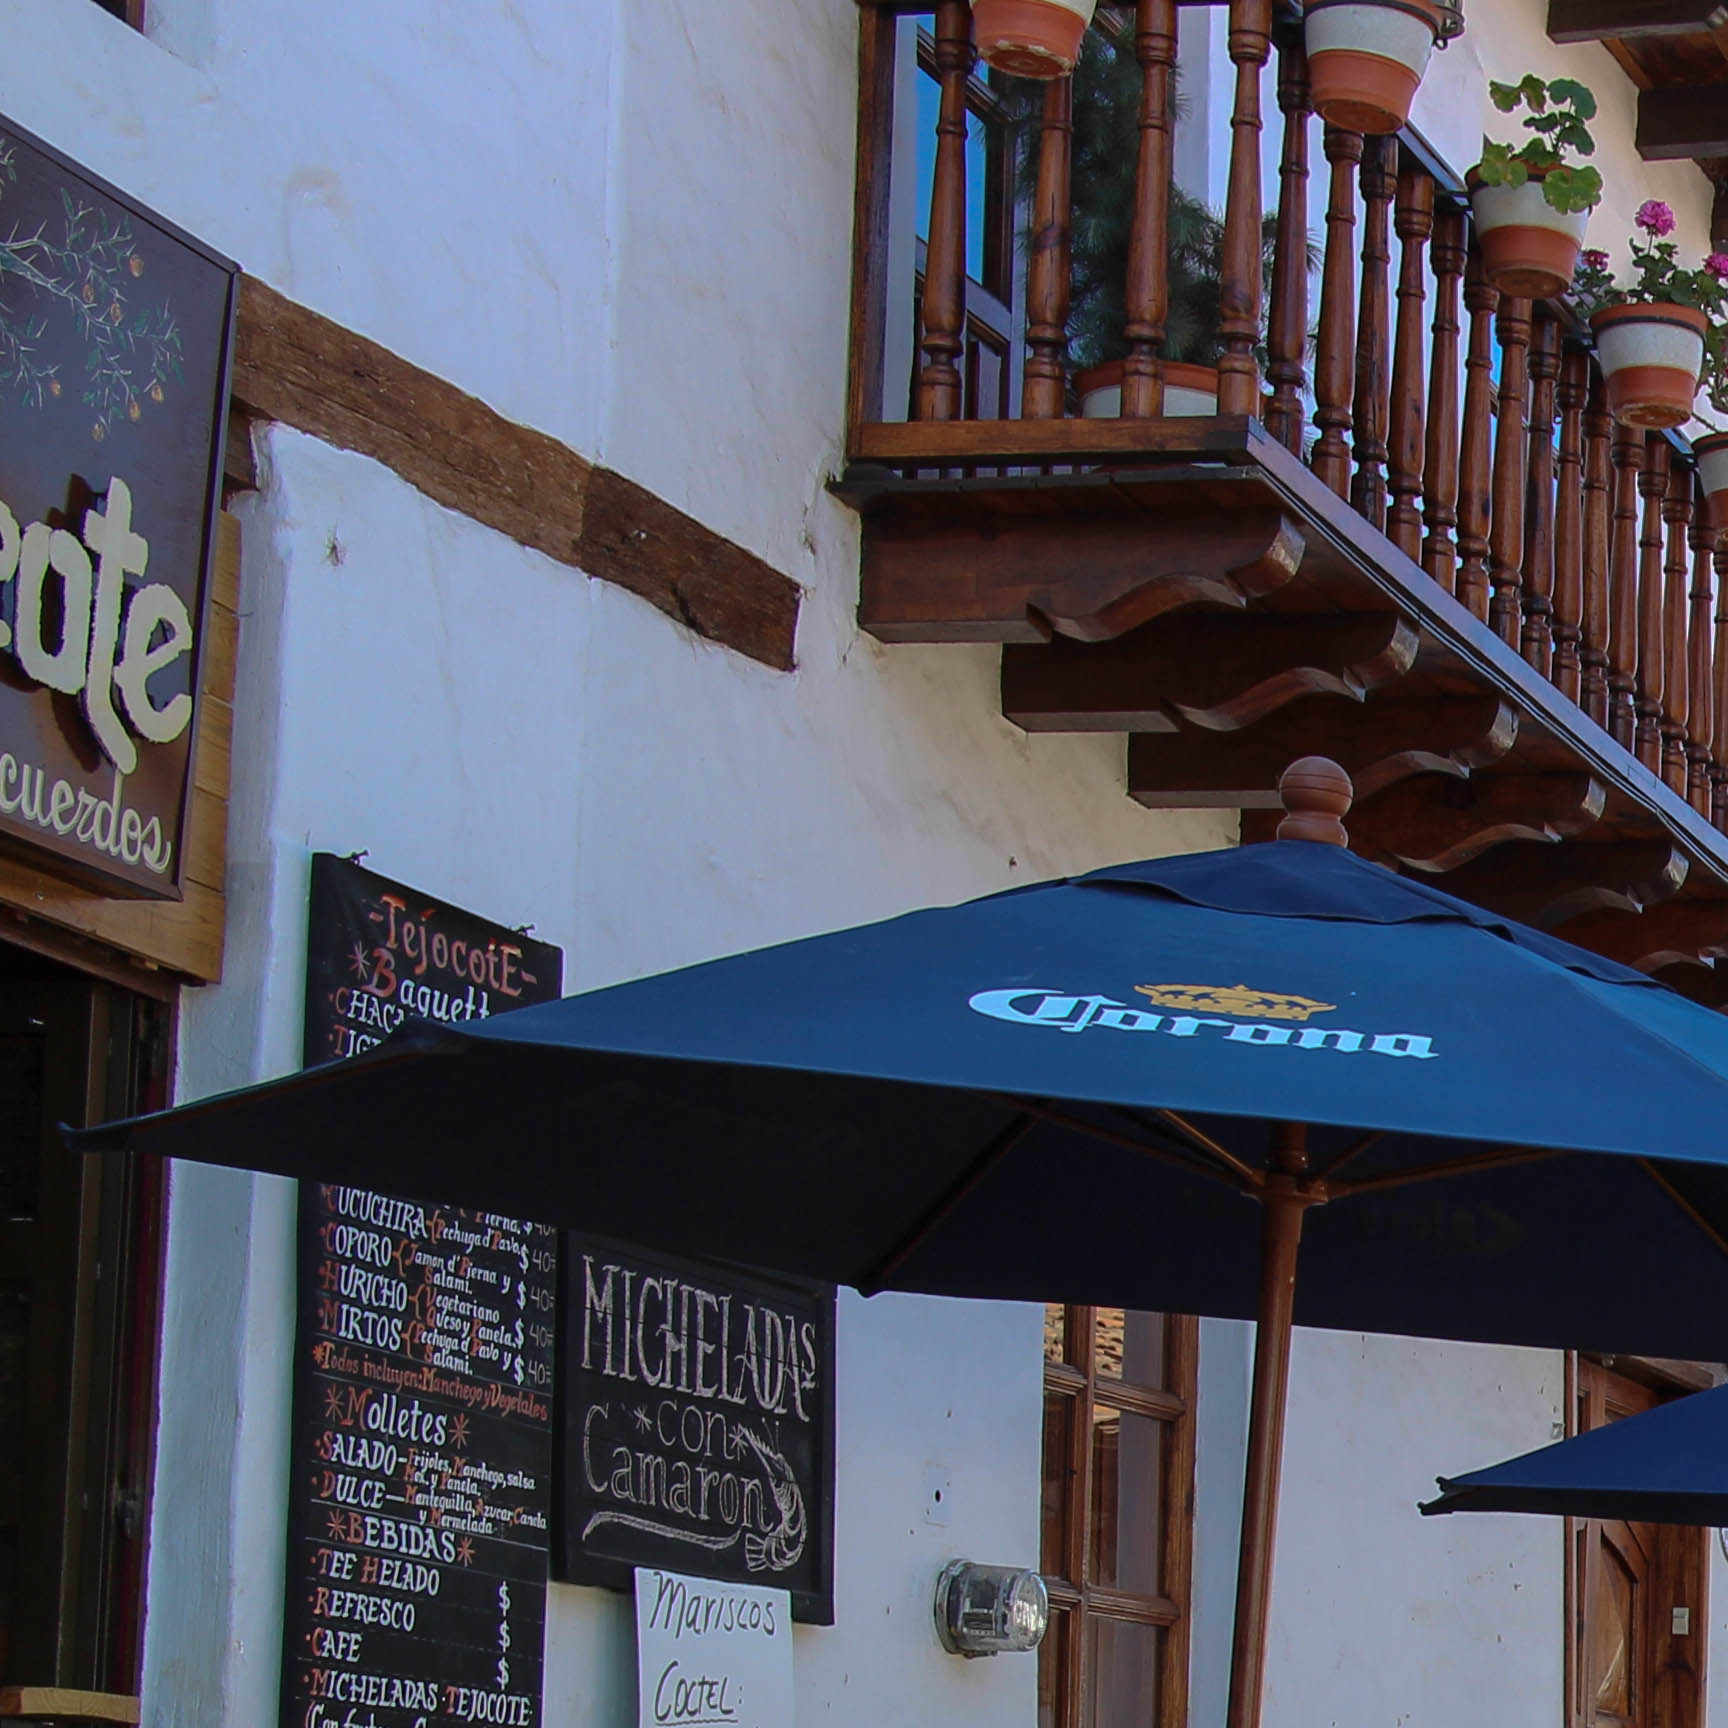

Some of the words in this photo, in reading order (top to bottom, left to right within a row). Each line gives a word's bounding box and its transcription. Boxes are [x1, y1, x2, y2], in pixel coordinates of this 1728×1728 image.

[968, 988, 1440, 1058] Corona
[322, 1260, 408, 1313] HURICHO
[326, 1222, 392, 1267] COPORO
[501, 1275, 511, 1294] y
[320, 1300, 402, 1351] MIRTOS
[503, 1351, 512, 1371] y
[461, 1321, 470, 1338] y
[581, 1255, 816, 1422] MICHELADAS
[340, 1386, 447, 1447] Molletes
[320, 1430, 397, 1476] SALADO
[431, 1473, 439, 1489] y
[584, 1402, 774, 1533] Camaron
[320, 1470, 386, 1509] DULCE
[419, 1509, 428, 1525] y
[347, 1511, 456, 1563] BEBIDAS
[318, 1548, 358, 1581] TEE
[361, 1555, 440, 1596] HELADO
[498, 1580, 511, 1618] $
[649, 1571, 776, 1639] Mariscos
[312, 1586, 415, 1632] REFRESCO
[498, 1619, 511, 1654] $
[311, 1626, 363, 1662] CAFE
[496, 1656, 510, 1690] $
[310, 1667, 438, 1712] MICHELADAS
